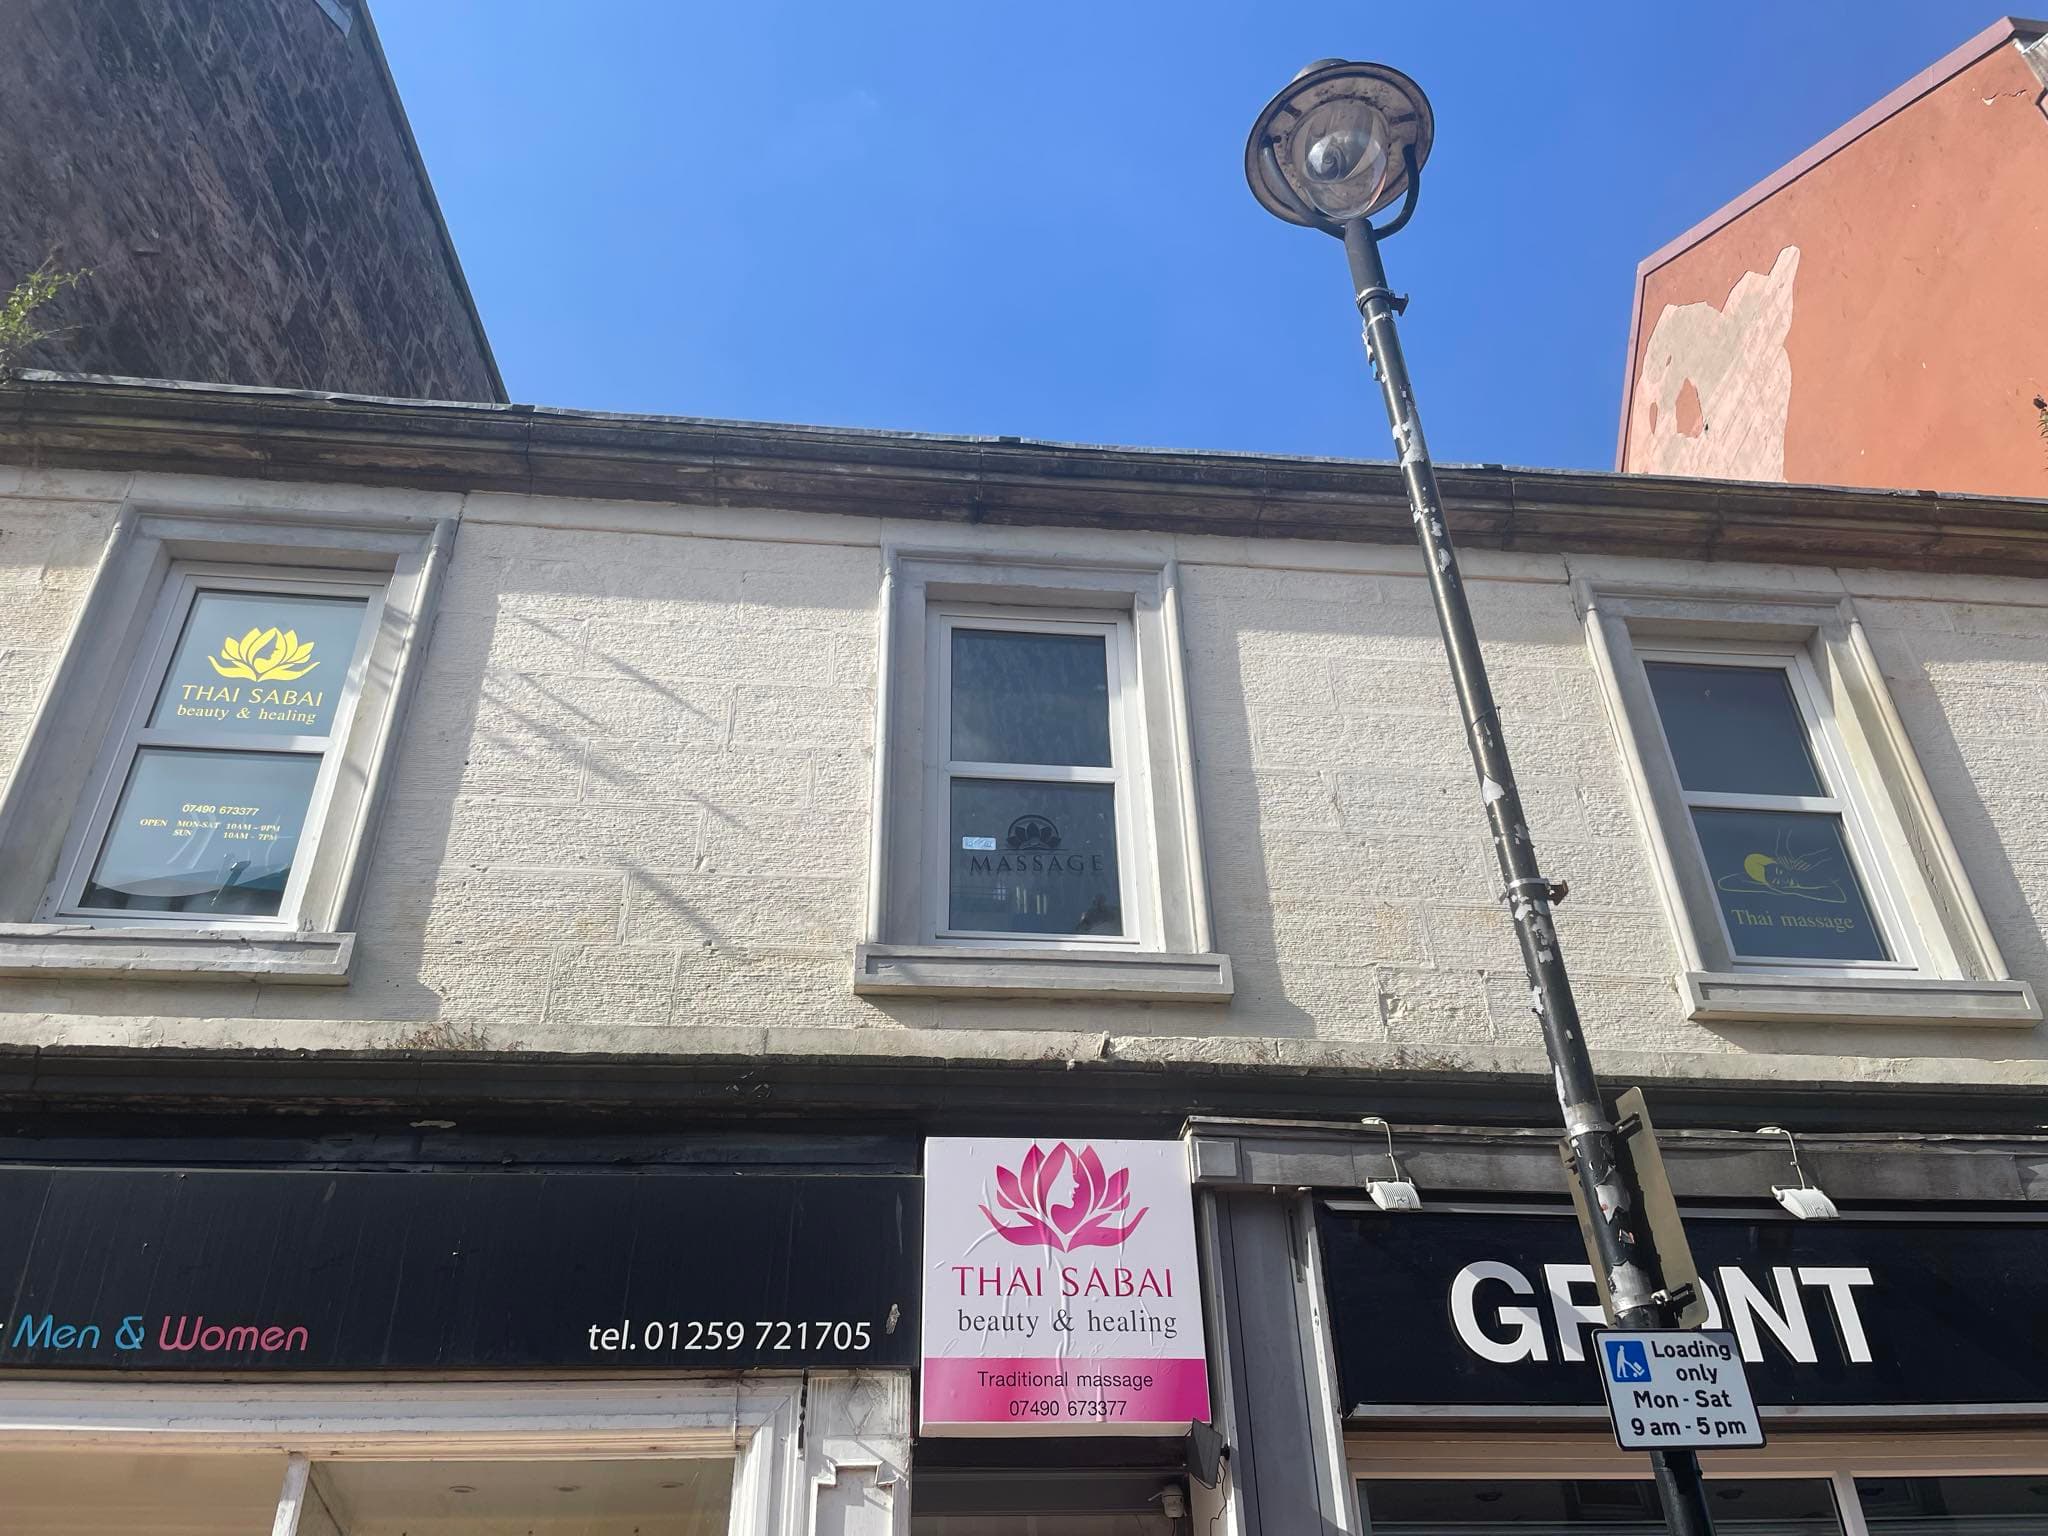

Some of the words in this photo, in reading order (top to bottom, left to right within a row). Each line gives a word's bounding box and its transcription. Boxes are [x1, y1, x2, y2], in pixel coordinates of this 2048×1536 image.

[182, 684, 240, 702] THAI
[248, 688, 323, 707] SABAI
[177, 704, 229, 720] beauty
[236, 707, 250, 719] &
[258, 708, 316, 725] healing
[182, 804, 216, 814] 07490
[219, 806, 260, 816] 673377
[139, 818, 168, 827] OPEN
[226, 823, 252, 831] 10AM
[172, 828, 193, 837] SUN
[223, 831, 249, 840] 10AM
[970, 854, 1104, 873] MASSAGE
[1731, 909, 1773, 926] Thai
[1780, 914, 1855, 933] massage
[952, 1266, 1043, 1296] THAI
[1062, 1266, 1174, 1297] SABAI
[12, 1313, 101, 1349] Men
[114, 1316, 145, 1350] &
[158, 1315, 309, 1351] Women
[958, 1309, 1040, 1337] beauty
[1053, 1309, 1074, 1332] &
[1088, 1310, 1178, 1338] healing
[588, 1319, 637, 1351] tel.
[643, 1321, 745, 1351] 01259
[754, 1321, 872, 1351] 721705
[1651, 1340, 1732, 1361] Loading
[977, 1371, 1068, 1388] Traditional
[1076, 1374, 1153, 1391] massage
[1675, 1363, 1718, 1385] only
[1009, 1401, 1059, 1416] 07490
[1067, 1400, 1127, 1416] 673377
[1633, 1390, 1679, 1408] Mon
[1694, 1389, 1732, 1408] Sat
[1631, 1417, 1645, 1436] 9
[1650, 1421, 1681, 1436] am
[1696, 1416, 1711, 1435] 5
[1714, 1420, 1747, 1438] pm
